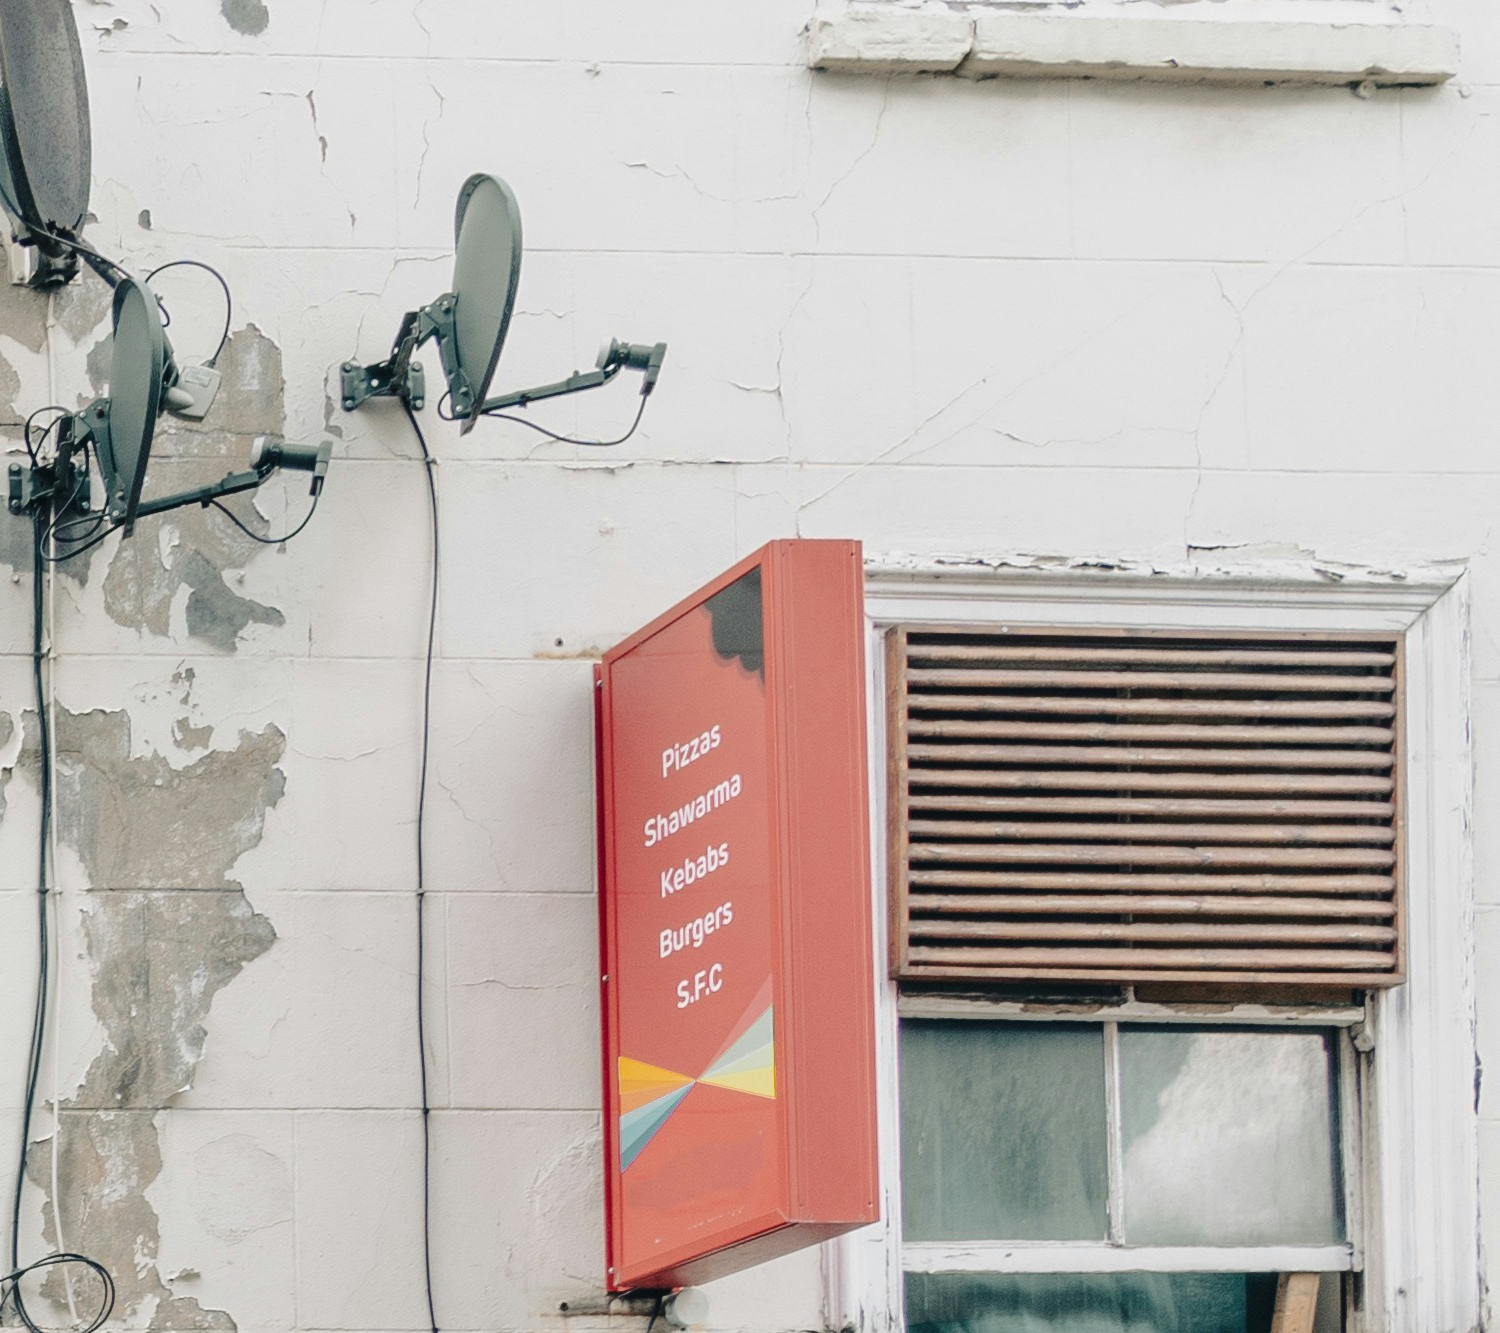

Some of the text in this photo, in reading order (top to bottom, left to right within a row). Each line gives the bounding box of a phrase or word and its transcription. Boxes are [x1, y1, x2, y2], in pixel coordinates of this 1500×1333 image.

[661, 724, 721, 778] Pizzas
[643, 774, 742, 847] Shawarma
[660, 843, 729, 898] Kebabs
[659, 902, 733, 958] Burgers
[676, 963, 724, 1009] S.F.C
